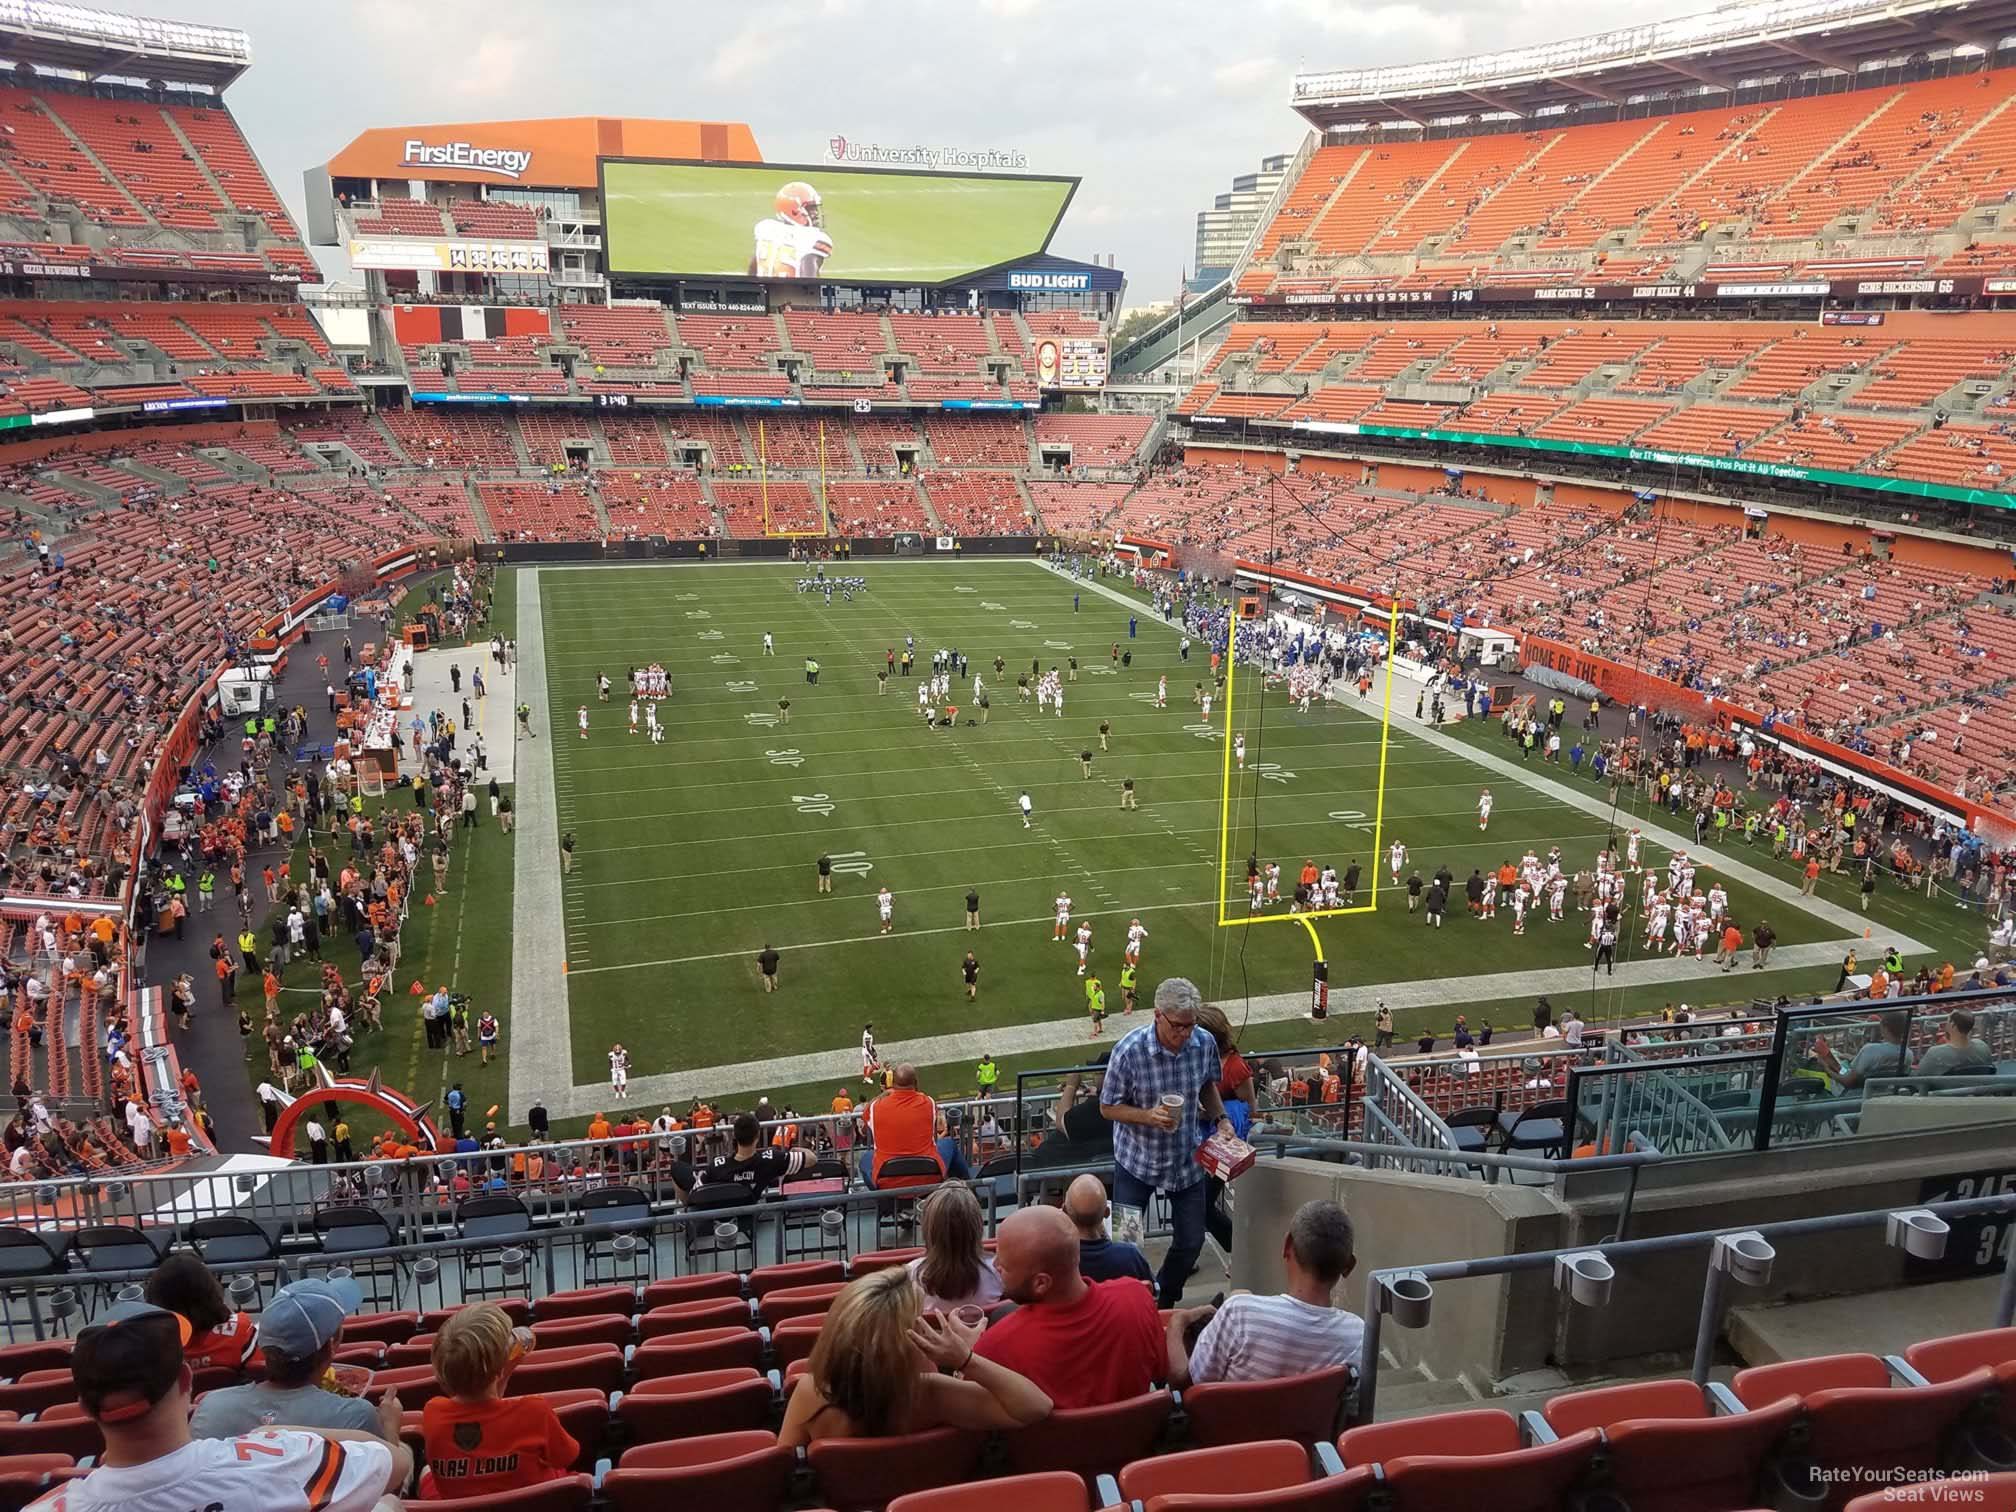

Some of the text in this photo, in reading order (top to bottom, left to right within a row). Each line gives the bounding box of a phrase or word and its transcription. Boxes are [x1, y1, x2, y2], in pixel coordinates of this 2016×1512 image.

[404, 139, 532, 171] FirstEnergy
[846, 143, 1025, 171] University Hospitals
[1010, 274, 1089, 288] BUD LIGHT
[1683, 285, 1695, 296] 44
[1629, 449, 1642, 460] Our
[1716, 459, 1733, 469] Pros
[1525, 643, 1597, 685] HOME OF THE
[432, 1453, 519, 1478] PLAY LOUD
